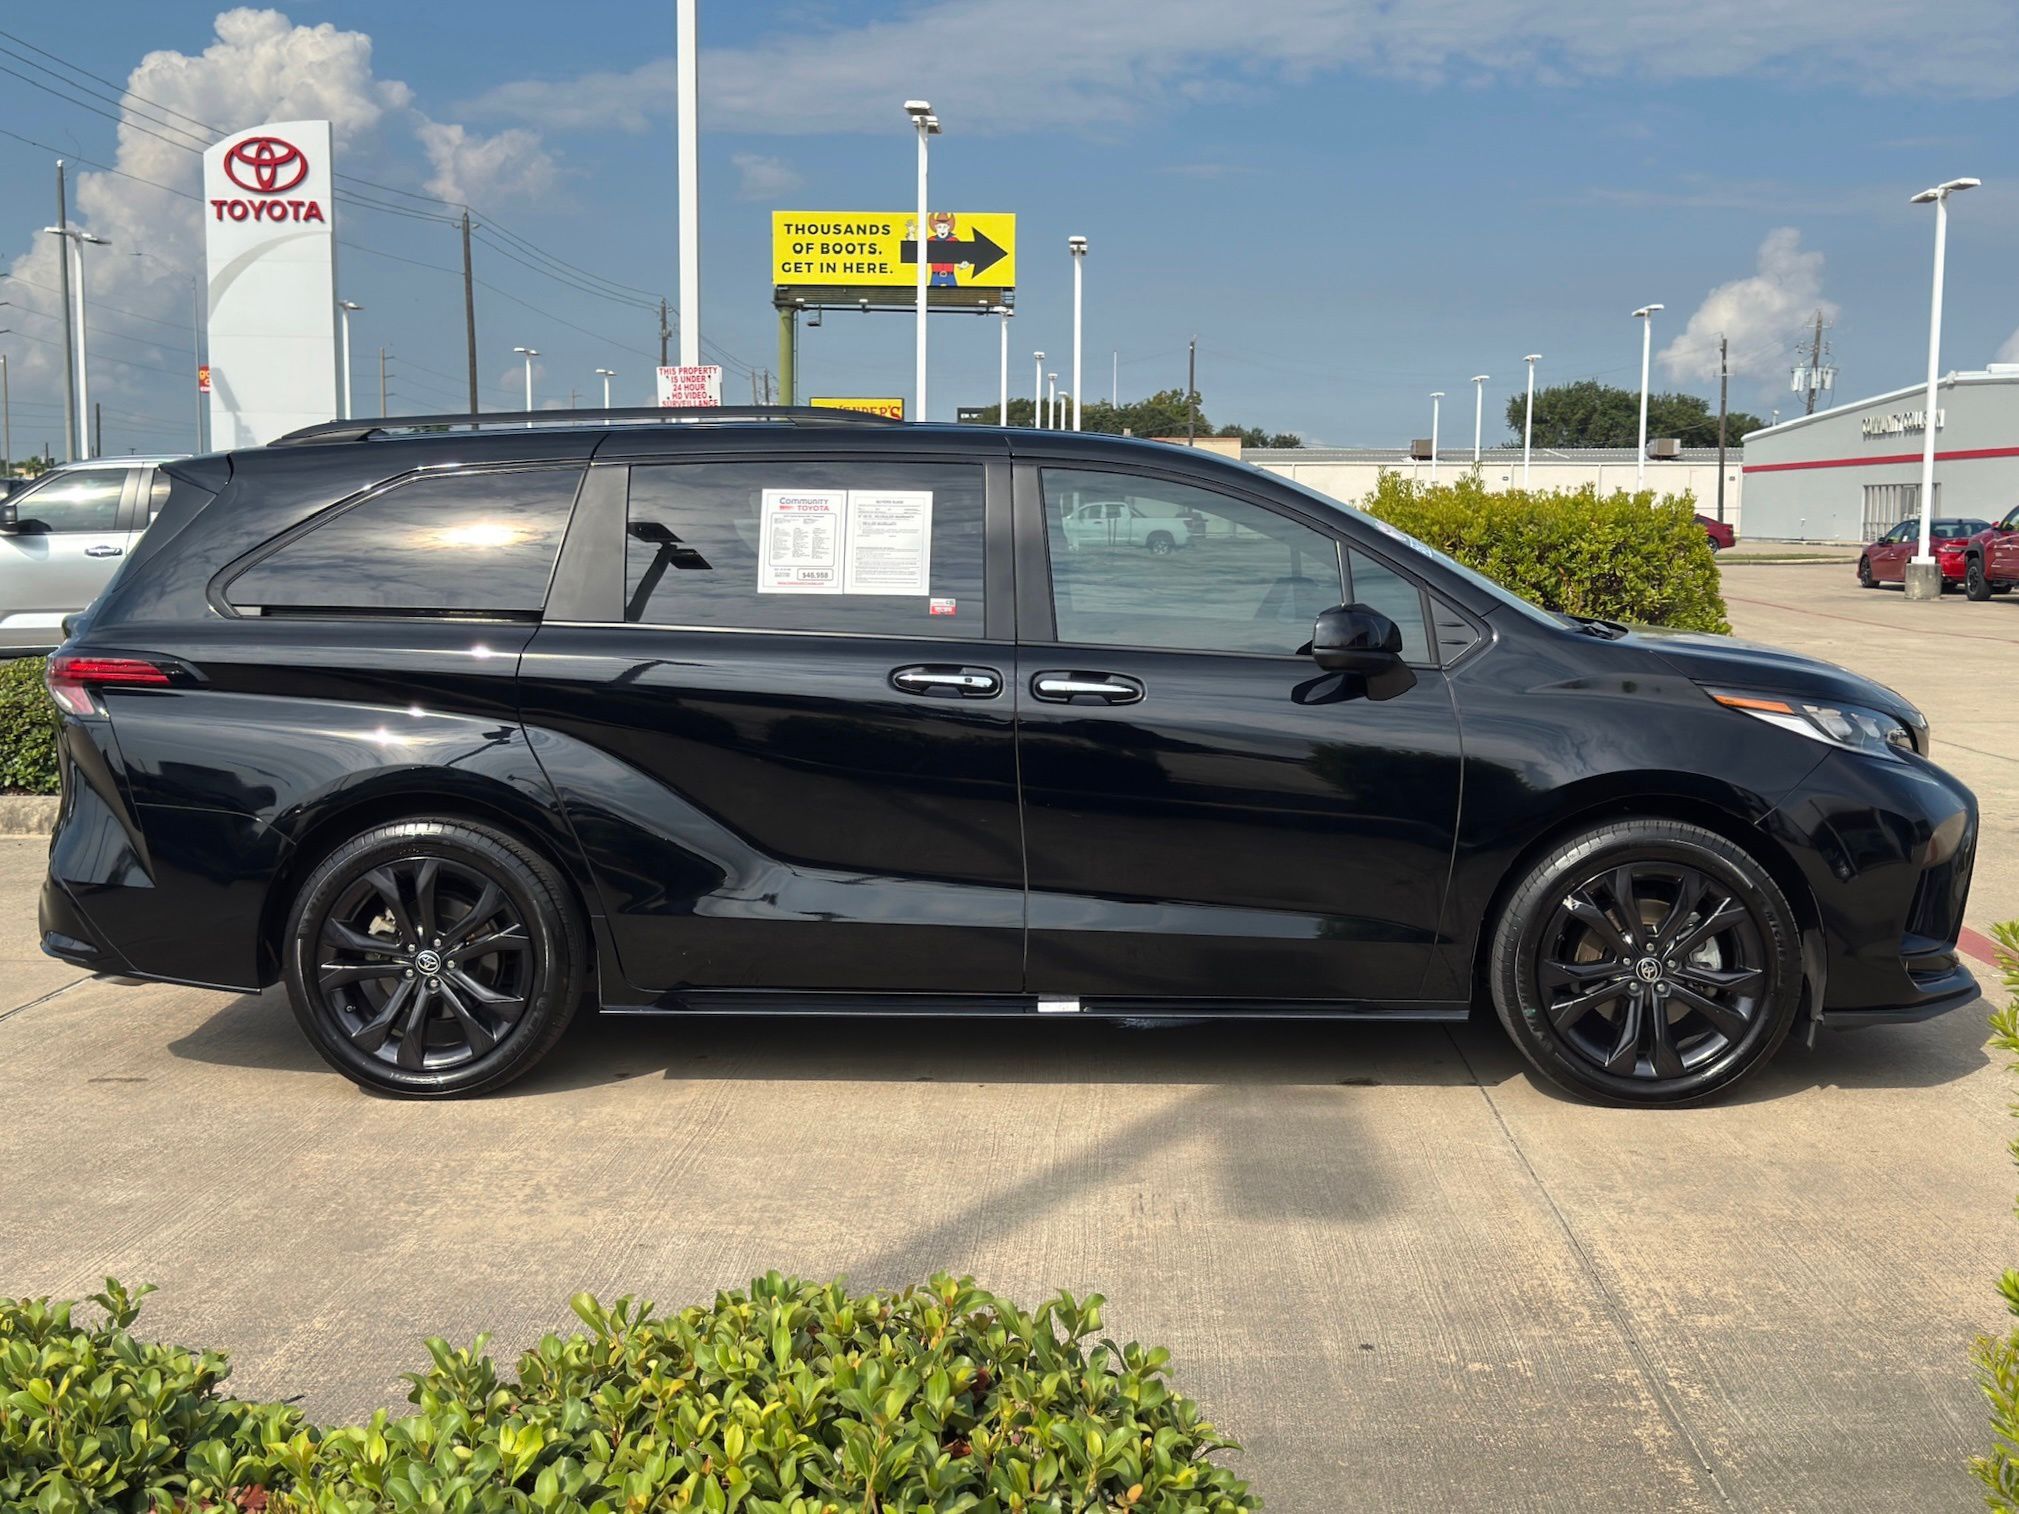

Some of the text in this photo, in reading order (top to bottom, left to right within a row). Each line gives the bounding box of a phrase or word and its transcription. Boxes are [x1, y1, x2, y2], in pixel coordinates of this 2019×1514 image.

[211, 199, 324, 222] TOYOTA
[784, 223, 891, 236] THOUSANDS
[792, 242, 883, 256] OF BOOTS.
[781, 262, 894, 274] GET IN HERE.
[659, 367, 717, 375] THIS PROPERTY
[680, 375, 707, 383] UNDER
[662, 399, 718, 407] SURVEILLANCE
